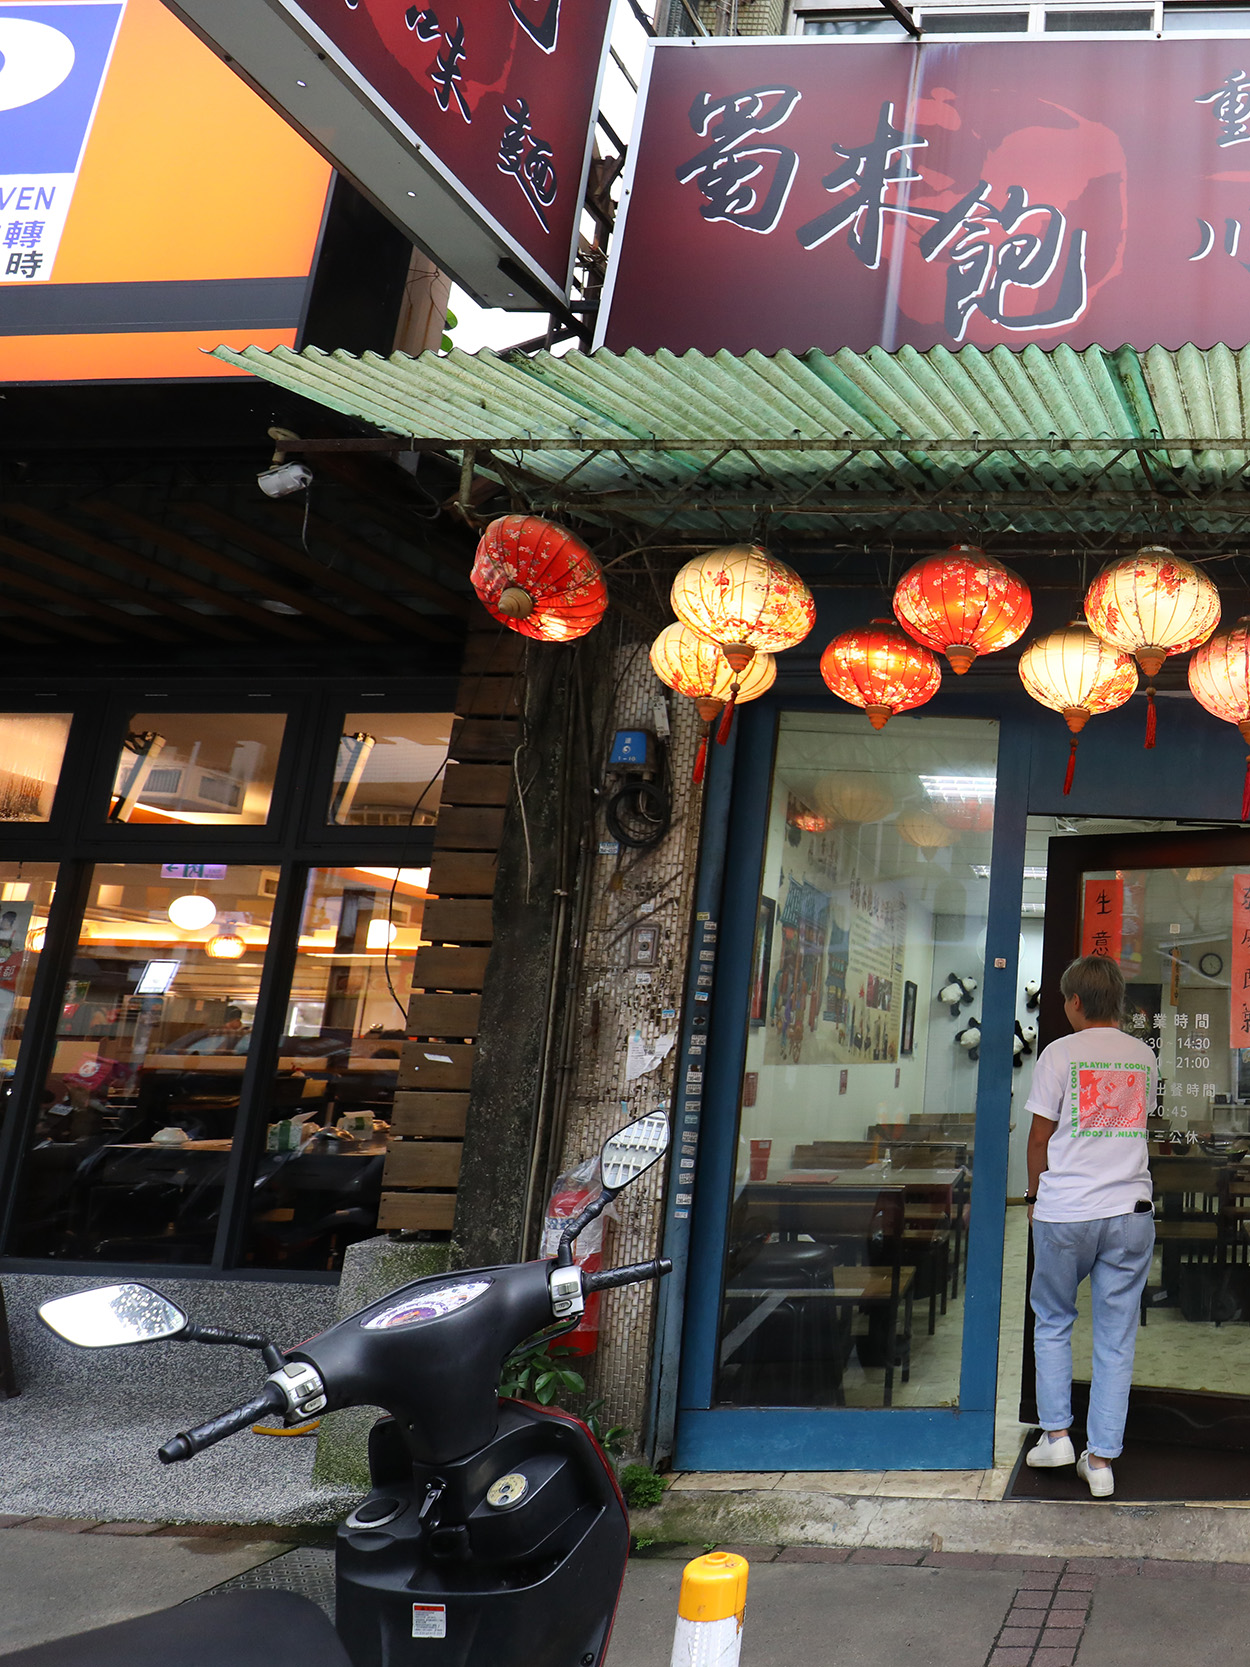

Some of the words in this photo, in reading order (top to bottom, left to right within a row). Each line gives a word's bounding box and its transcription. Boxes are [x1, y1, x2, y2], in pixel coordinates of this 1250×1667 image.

[0, 221, 46, 249] 轉
[5, 250, 43, 279] 時
[1091, 889, 1112, 956] 生意
[1132, 1012, 1210, 1030] 營業時間
[1141, 1037, 1163, 1049] :30
[1177, 1037, 1210, 1049] 14:30
[1079, 1061, 1111, 1069] PLAYIN'
[1176, 1057, 1210, 1069] 21:00
[1071, 1092, 1078, 1100] IT
